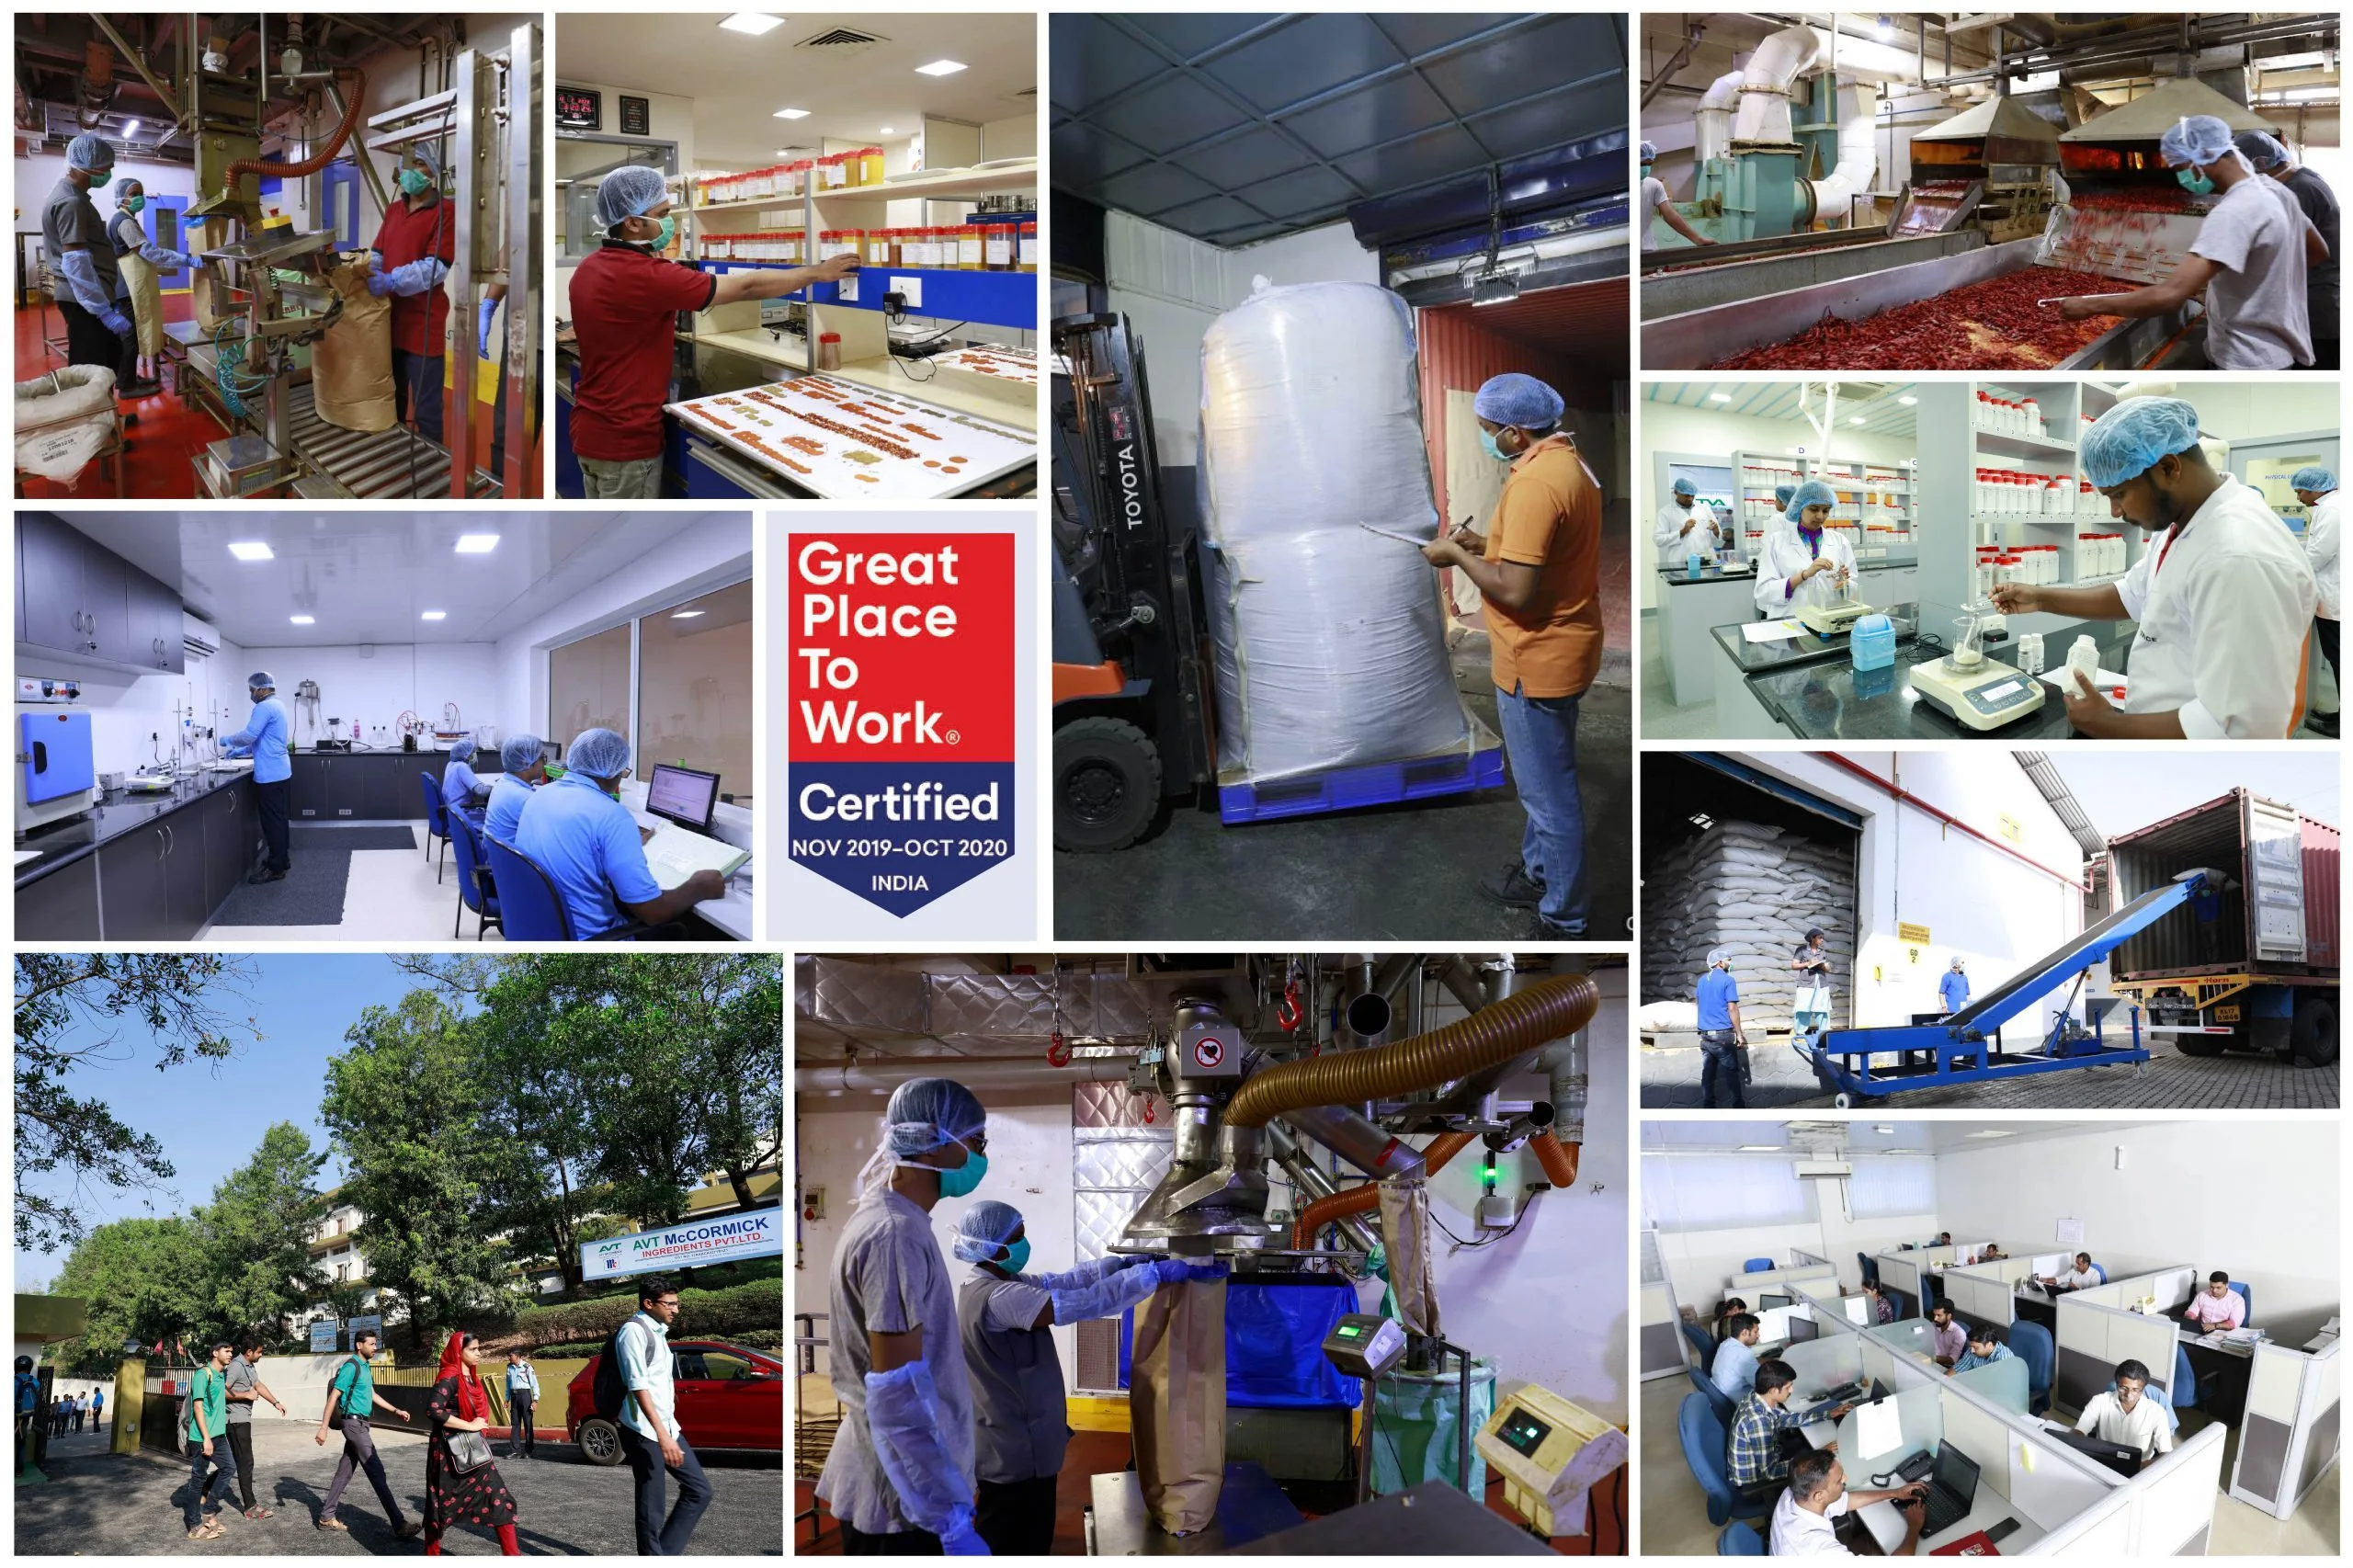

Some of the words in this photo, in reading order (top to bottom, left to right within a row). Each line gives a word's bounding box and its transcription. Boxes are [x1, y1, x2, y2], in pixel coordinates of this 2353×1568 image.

[1118, 444, 1142, 530] TOYOTA
[798, 540, 959, 585] Great
[803, 594, 958, 638] Place
[798, 648, 859, 690] To
[799, 781, 999, 822] Certified
[792, 838, 842, 857] NOV
[958, 838, 1007, 857] 2020
[872, 875, 929, 892] INDIA
[598, 1243, 622, 1253] AVT
[633, 1236, 660, 1251] AVT
[665, 1217, 769, 1245] McCORMICK
[642, 1240, 711, 1257] INGREDIENTS
